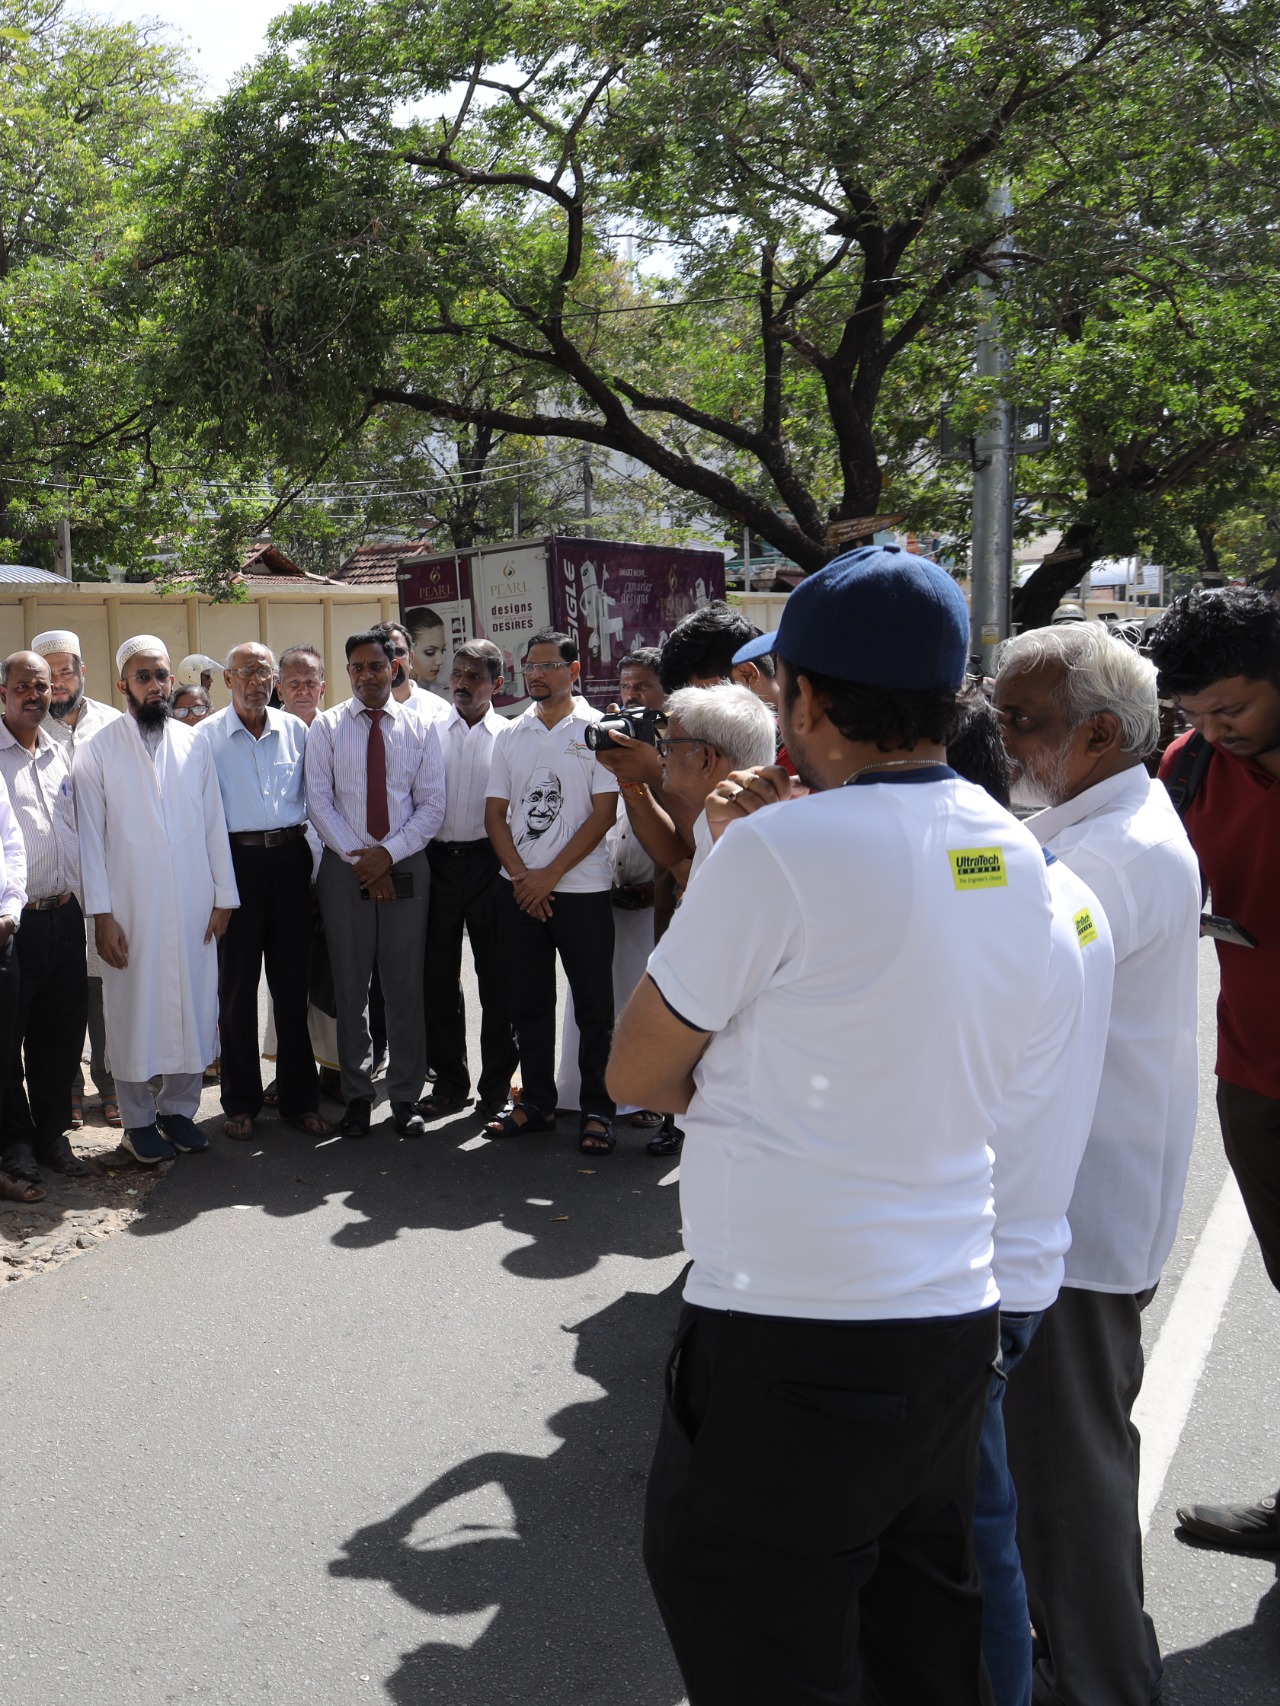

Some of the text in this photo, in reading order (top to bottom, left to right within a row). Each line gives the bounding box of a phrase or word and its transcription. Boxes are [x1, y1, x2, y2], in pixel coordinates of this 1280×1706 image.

[419, 584, 454, 598] PEARL
[490, 581, 531, 597] PEARL
[491, 603, 533, 616] designs
[492, 620, 534, 632] DESIRES
[956, 854, 999, 868] UltraTech
